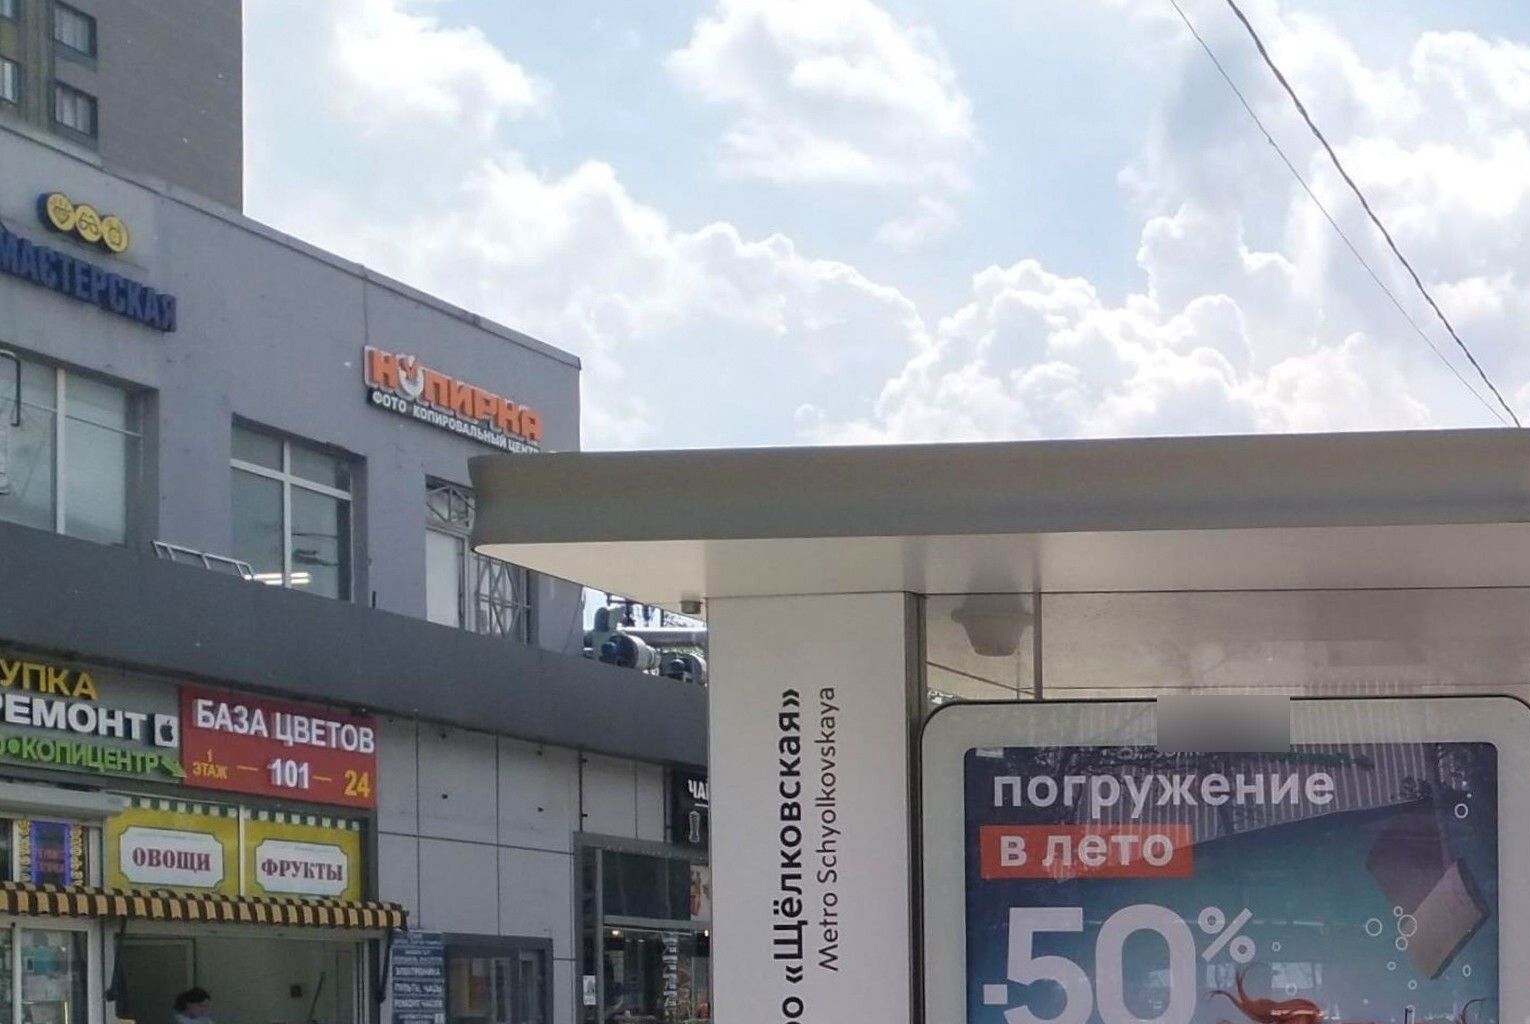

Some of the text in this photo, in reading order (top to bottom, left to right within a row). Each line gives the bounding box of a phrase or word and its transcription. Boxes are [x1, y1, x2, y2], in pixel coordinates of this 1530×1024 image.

[372, 391, 407, 413] ФОТО
[413, 403, 507, 448] КОПИРОВАЛЬНЫЙ
[0, 693, 147, 741] ЕМОНТ
[194, 698, 375, 754] БАЗА ЦВЕТОВ
[192, 757, 372, 798] ЭТАЖ 101 24
[687, 778, 708, 801] ЧА
[992, 771, 1336, 819] погружение
[773, 687, 809, 984] «Щёлковская»
[813, 686, 842, 972] Metro Schyolkovskaya
[1000, 832, 1175, 868] в лето
[132, 846, 212, 875] ОВОЩИ
[260, 857, 343, 882] ФРУКТЫ
